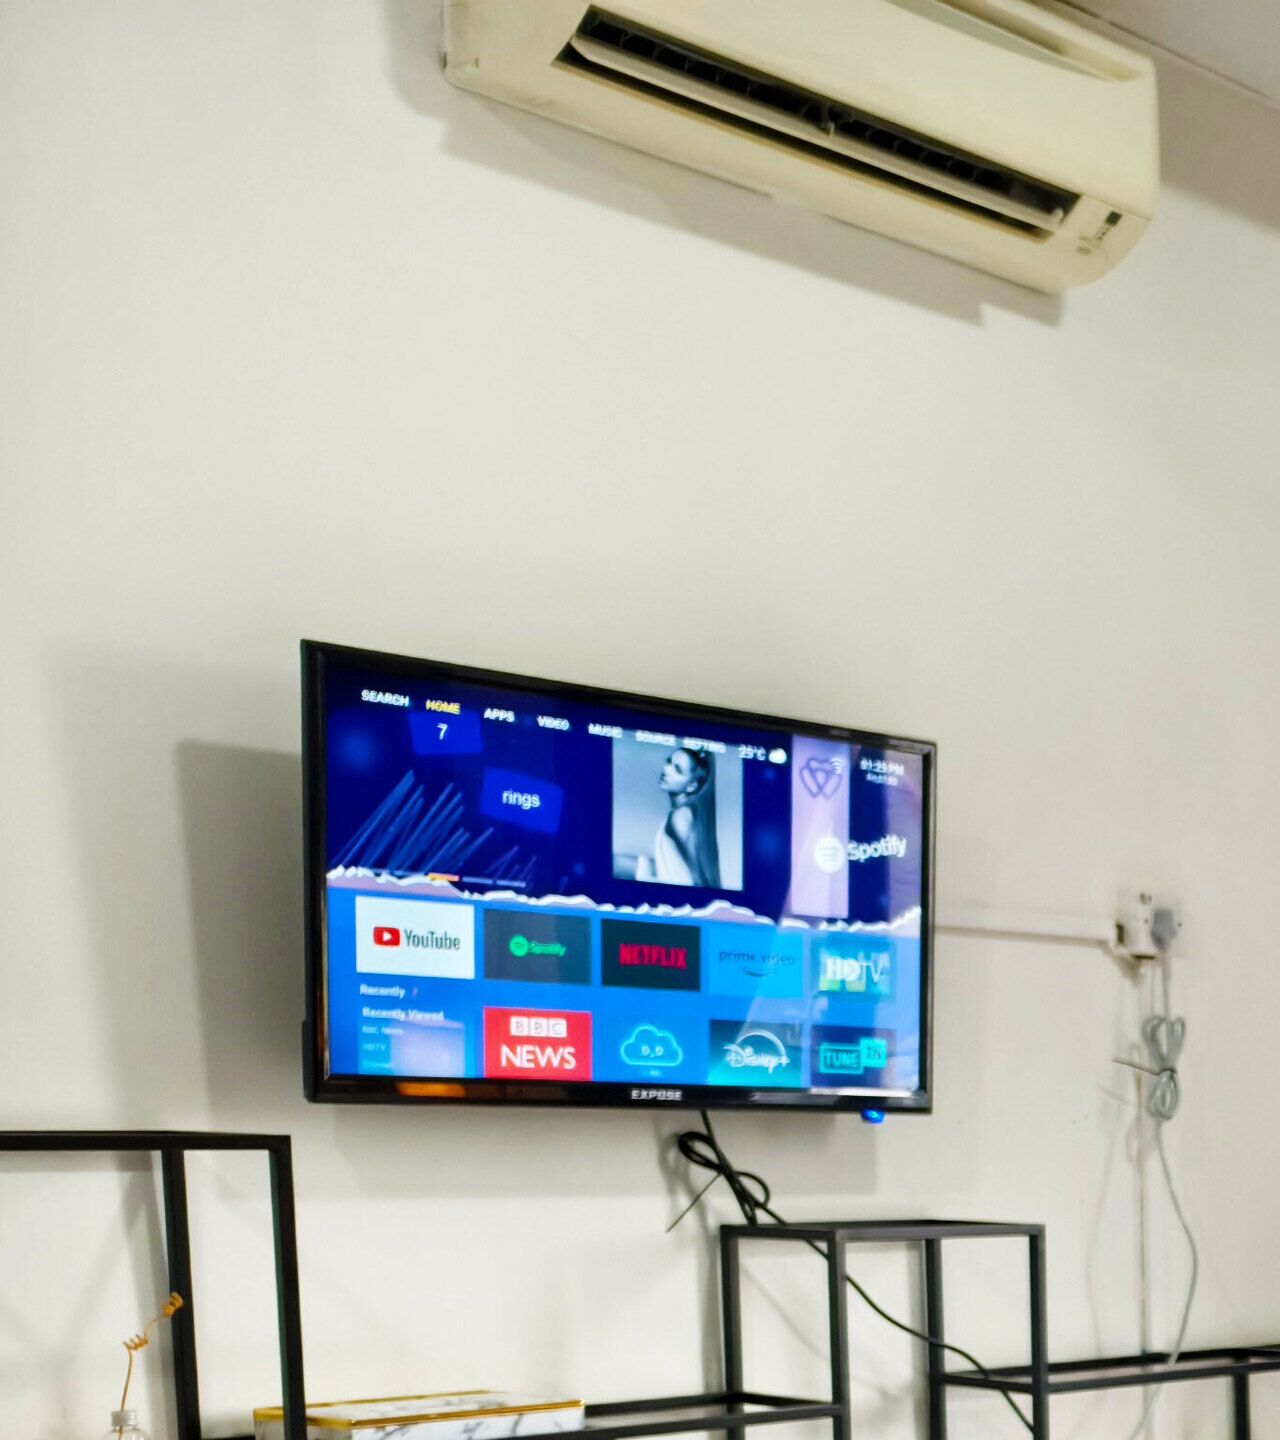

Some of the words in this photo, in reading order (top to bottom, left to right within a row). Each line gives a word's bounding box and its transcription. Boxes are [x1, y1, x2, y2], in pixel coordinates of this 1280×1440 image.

[361, 689, 410, 707] SEARCH
[426, 699, 461, 715] HOME
[484, 708, 515, 723] APPS
[537, 715, 570, 731] VIDEO
[437, 723, 448, 740] 7
[502, 786, 541, 811] rings
[847, 833, 908, 864] Spotify
[404, 929, 462, 951] YouTube
[619, 943, 688, 971] NETFLIX
[718, 951, 756, 963] prime
[360, 984, 406, 999] Recently
[362, 1007, 405, 1021] Recently
[407, 1009, 445, 1022] Viewed
[511, 1017, 566, 1037] BBC
[500, 1044, 576, 1070] NEWS
[823, 1050, 860, 1068] TUNE
[630, 1088, 683, 1101] EXPOSE
